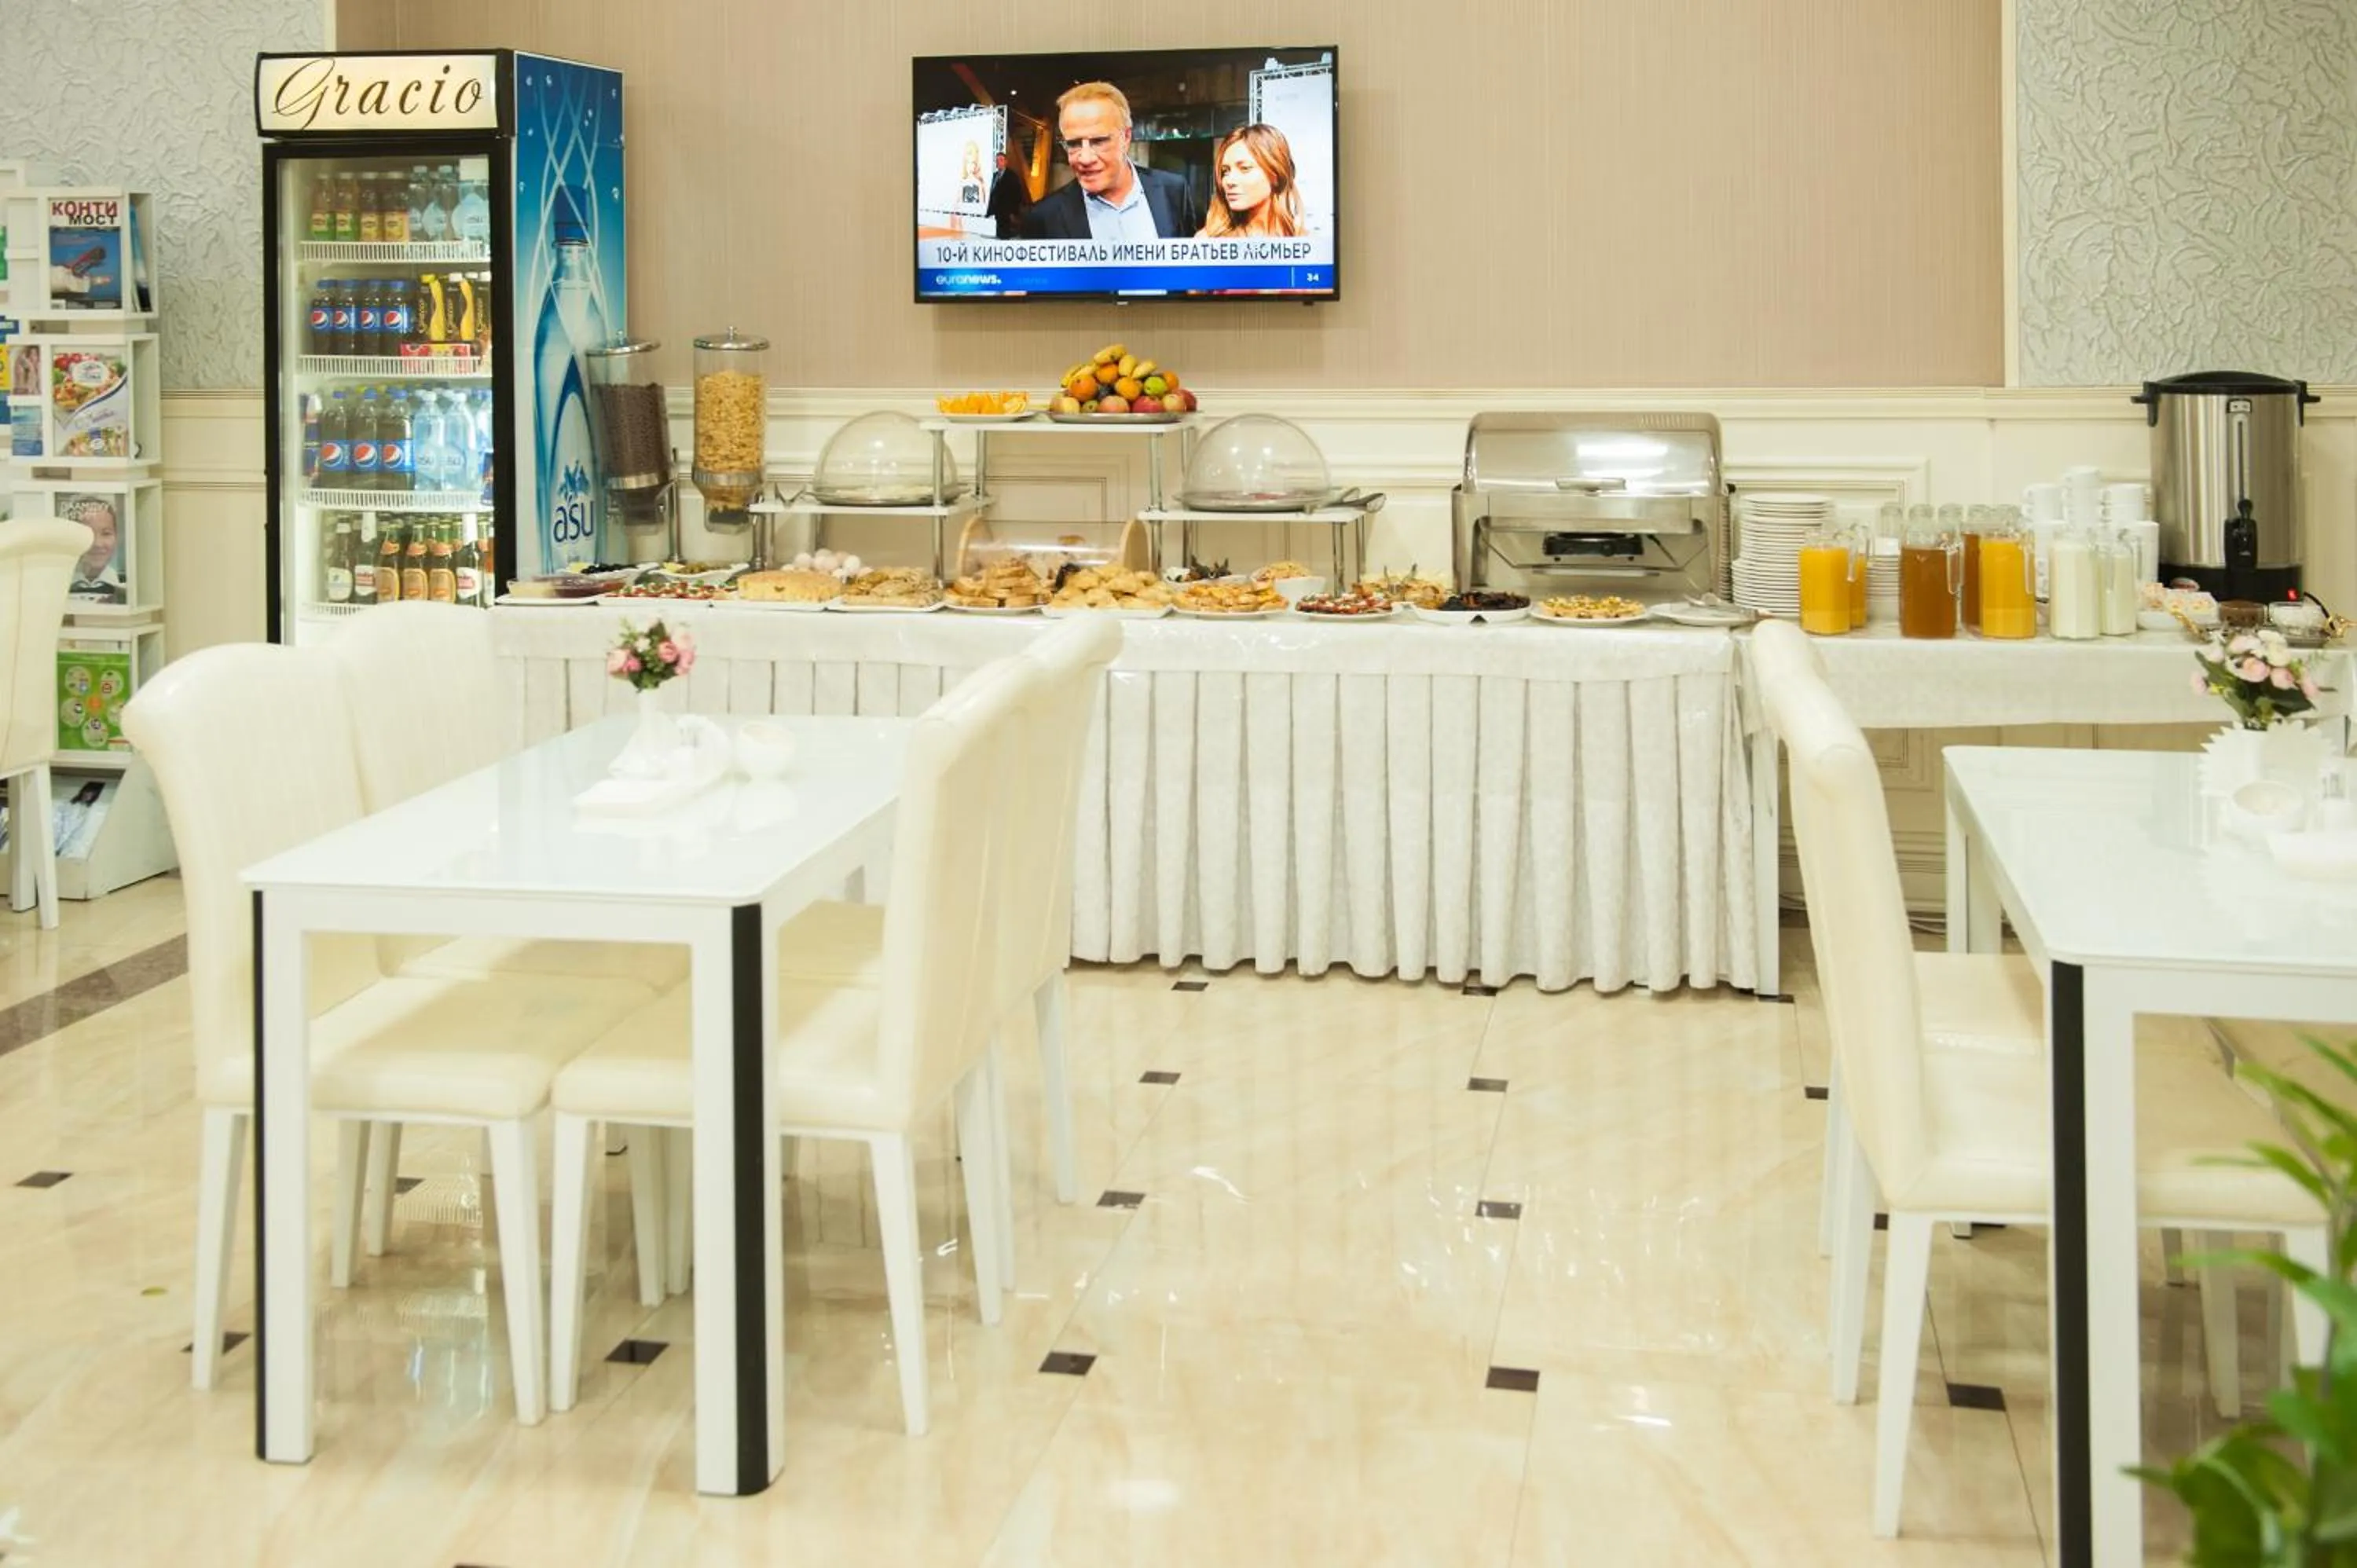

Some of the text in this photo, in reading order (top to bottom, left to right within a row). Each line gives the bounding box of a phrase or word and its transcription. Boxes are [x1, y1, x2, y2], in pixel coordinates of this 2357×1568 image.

[272, 57, 482, 129] Gracio
[52, 201, 117, 216] КОНТИ
[68, 214, 115, 225] МОСТ
[937, 243, 967, 262] 10-Й
[973, 245, 1108, 262] КИНОФЕСТИВАЛЬ
[1113, 244, 1165, 261] ИМЕНИ
[1171, 244, 1239, 260] БРАТЬЕВ
